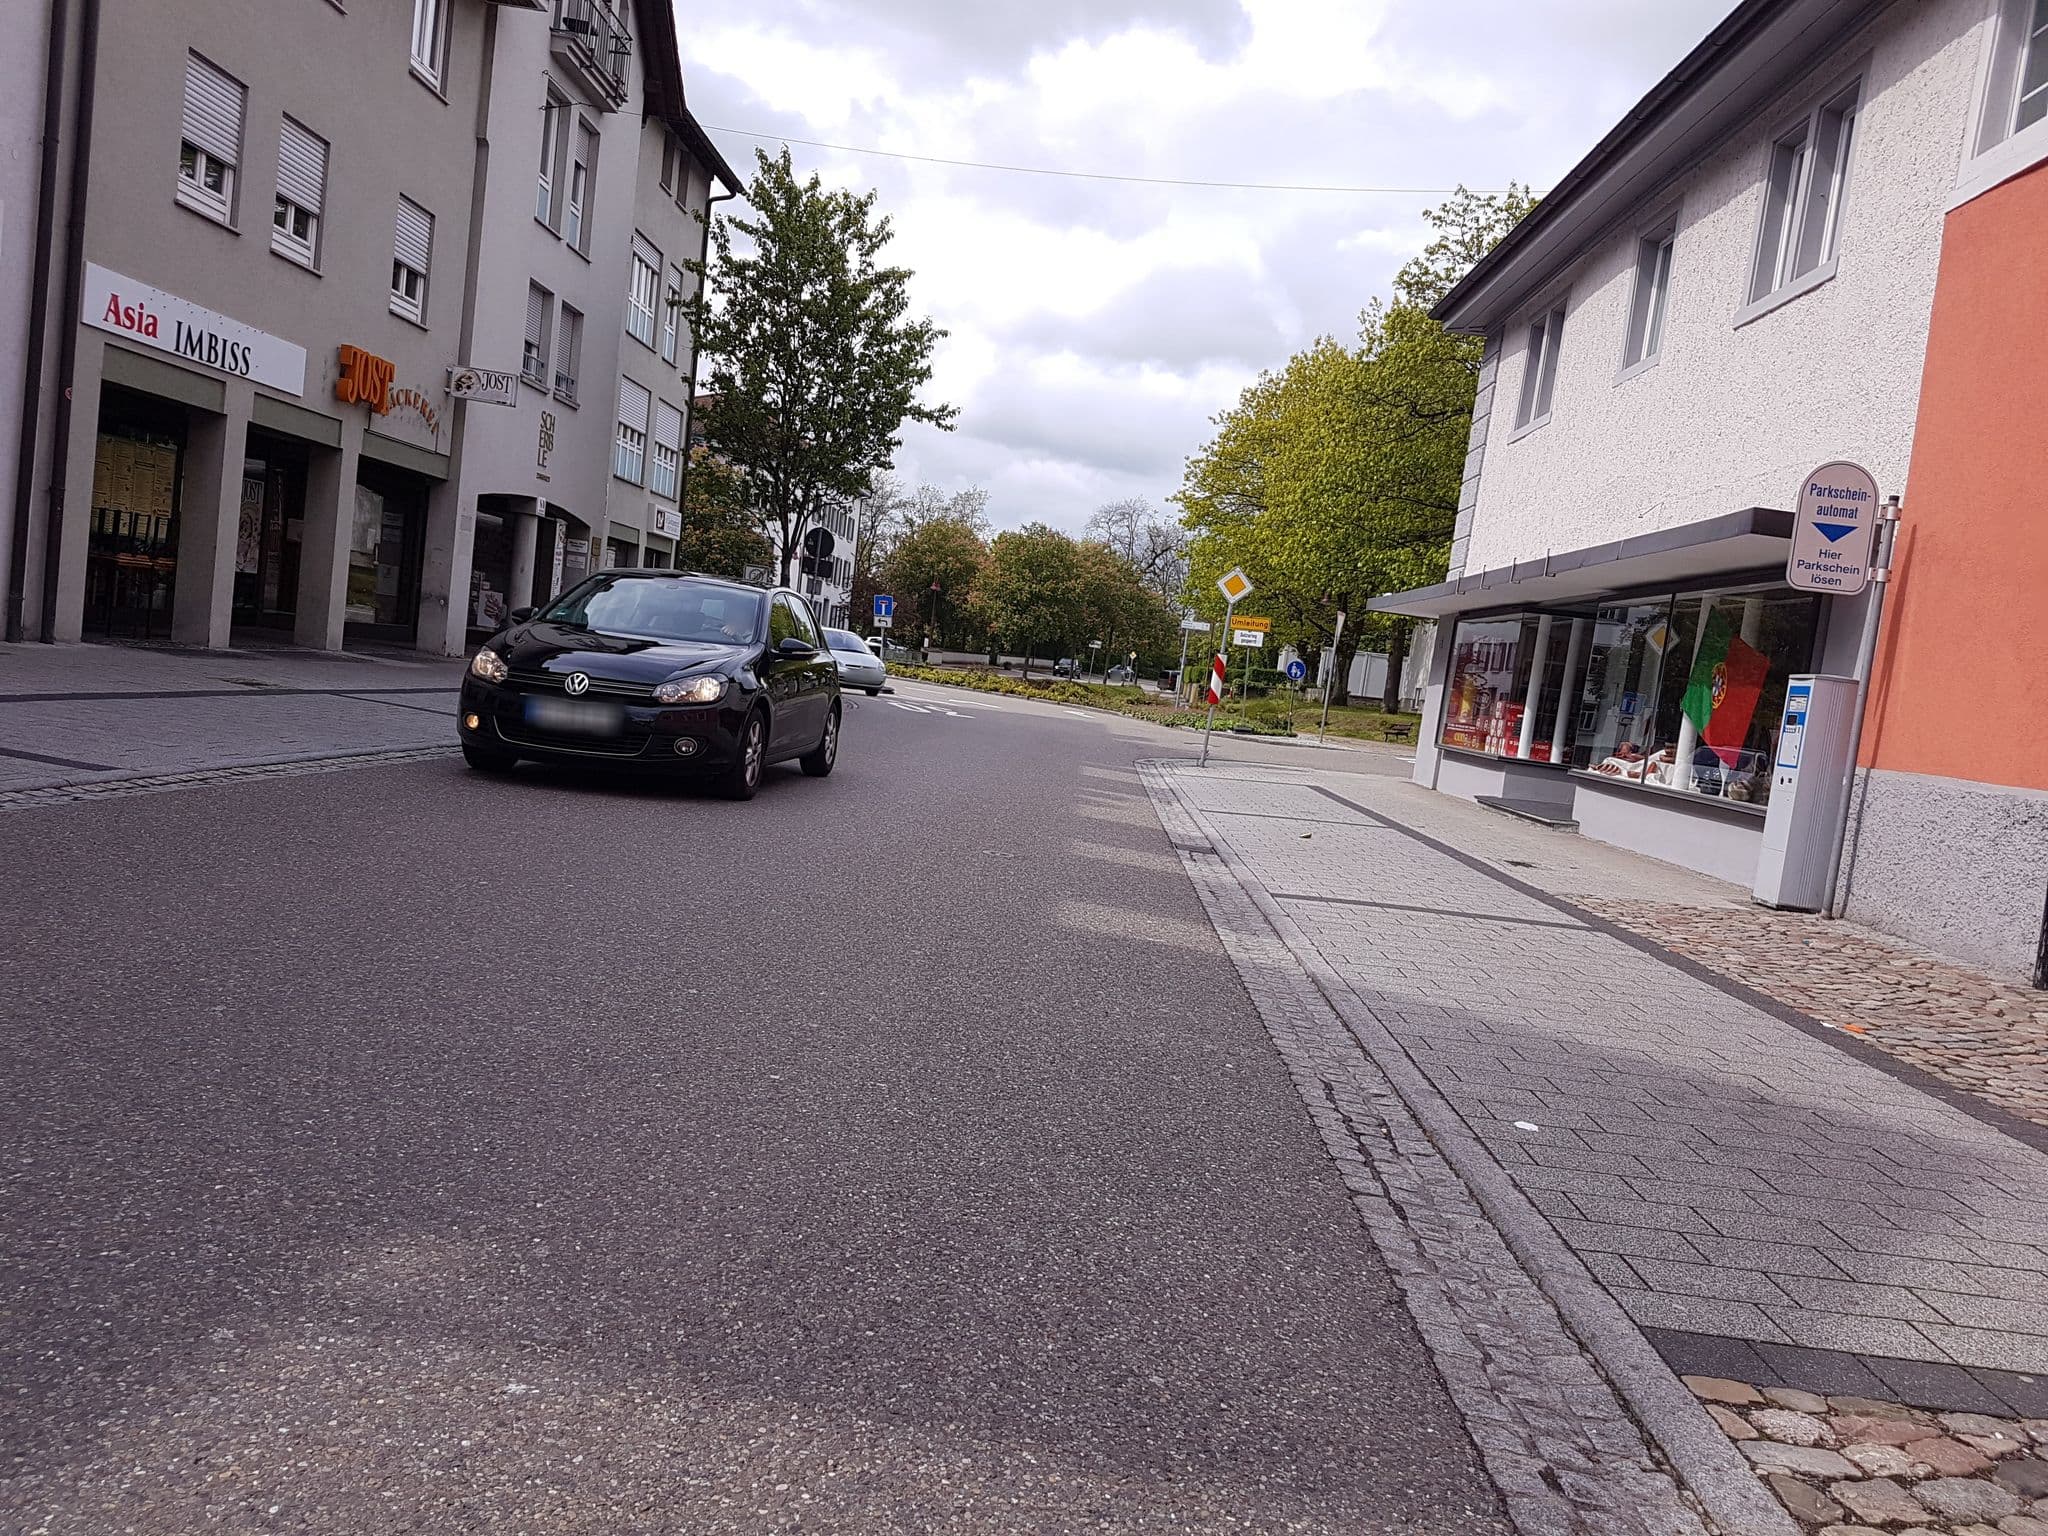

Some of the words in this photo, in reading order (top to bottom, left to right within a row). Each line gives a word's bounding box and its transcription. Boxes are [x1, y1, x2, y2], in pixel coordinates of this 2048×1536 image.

[102, 293, 159, 339] Asia
[174, 320, 252, 376] IMBISS
[338, 344, 395, 416] JOST
[481, 372, 513, 394] JOST
[1809, 483, 1872, 502] Parkschein-
[1816, 503, 1859, 520] automat
[1818, 548, 1843, 560] Hier
[1797, 559, 1860, 575] Parkschein
[1810, 573, 1842, 586] lösen
[1231, 617, 1269, 630] Umleitung
